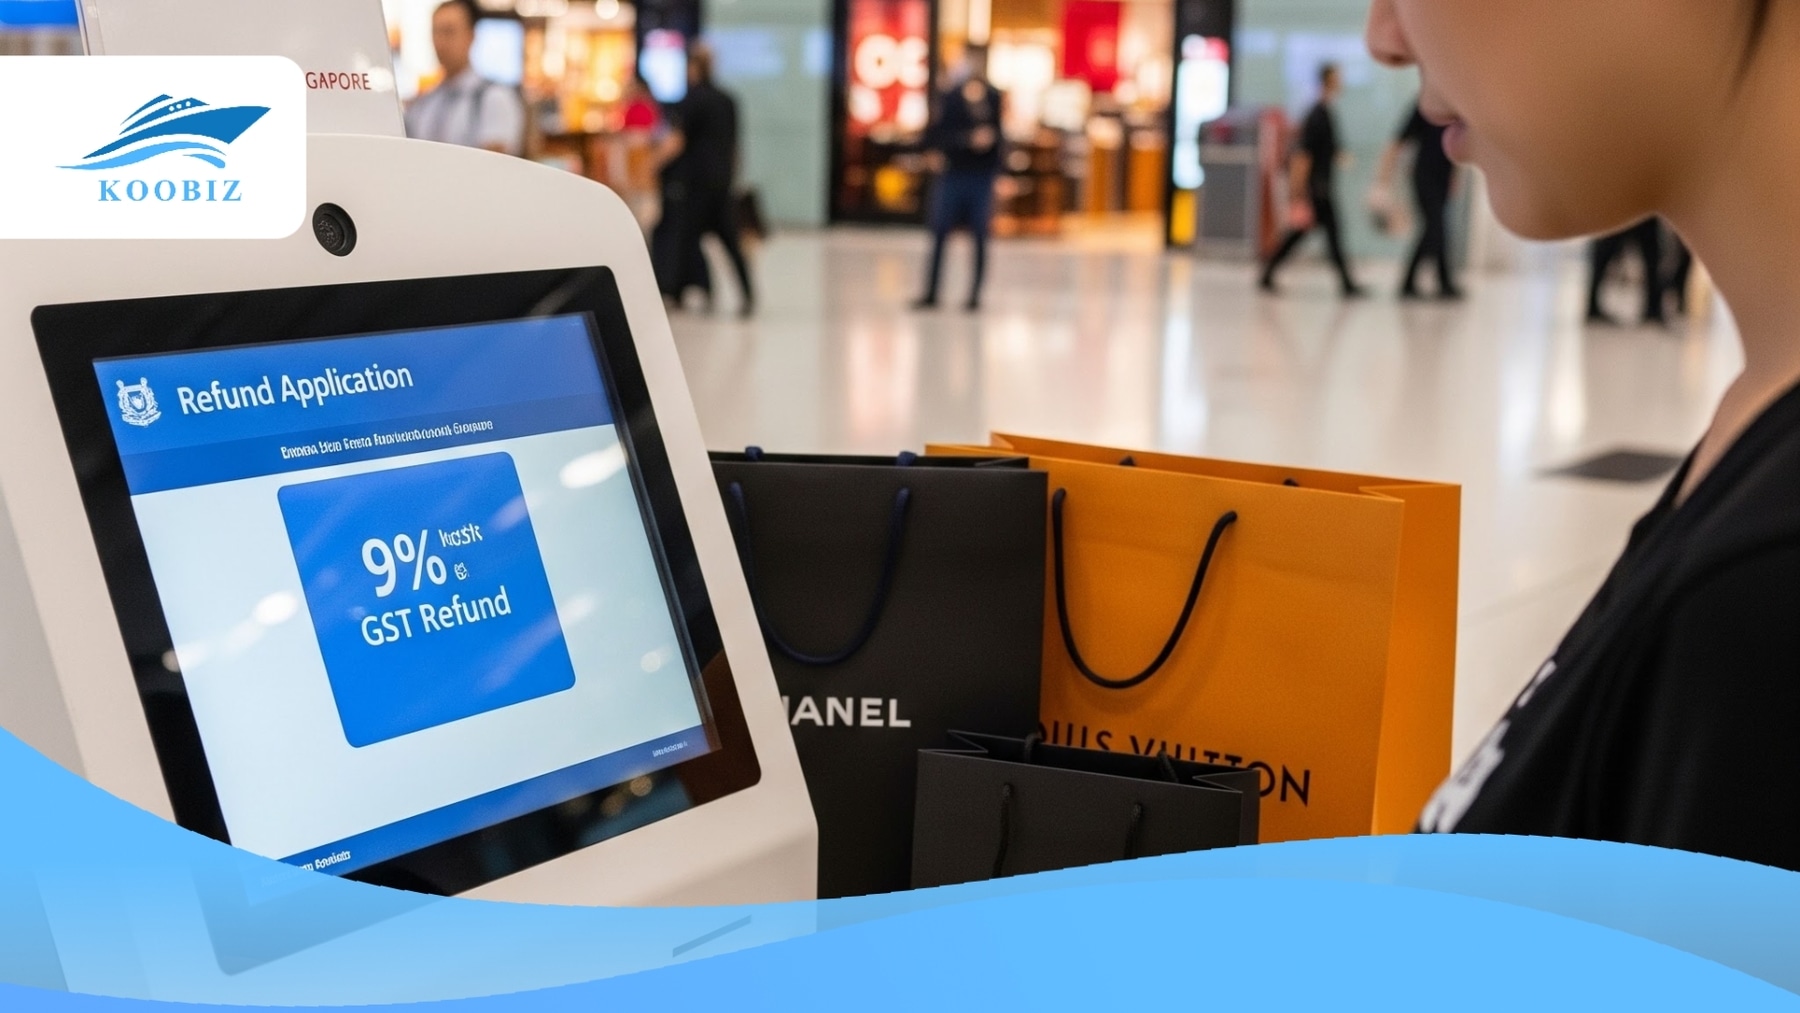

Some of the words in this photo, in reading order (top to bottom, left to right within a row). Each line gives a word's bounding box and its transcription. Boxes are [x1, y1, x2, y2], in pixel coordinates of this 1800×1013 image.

[176, 375, 276, 415] Refund
[280, 362, 414, 409] Application
[361, 528, 448, 598] 9%
[360, 607, 413, 647] GST
[418, 584, 512, 634] Refund
